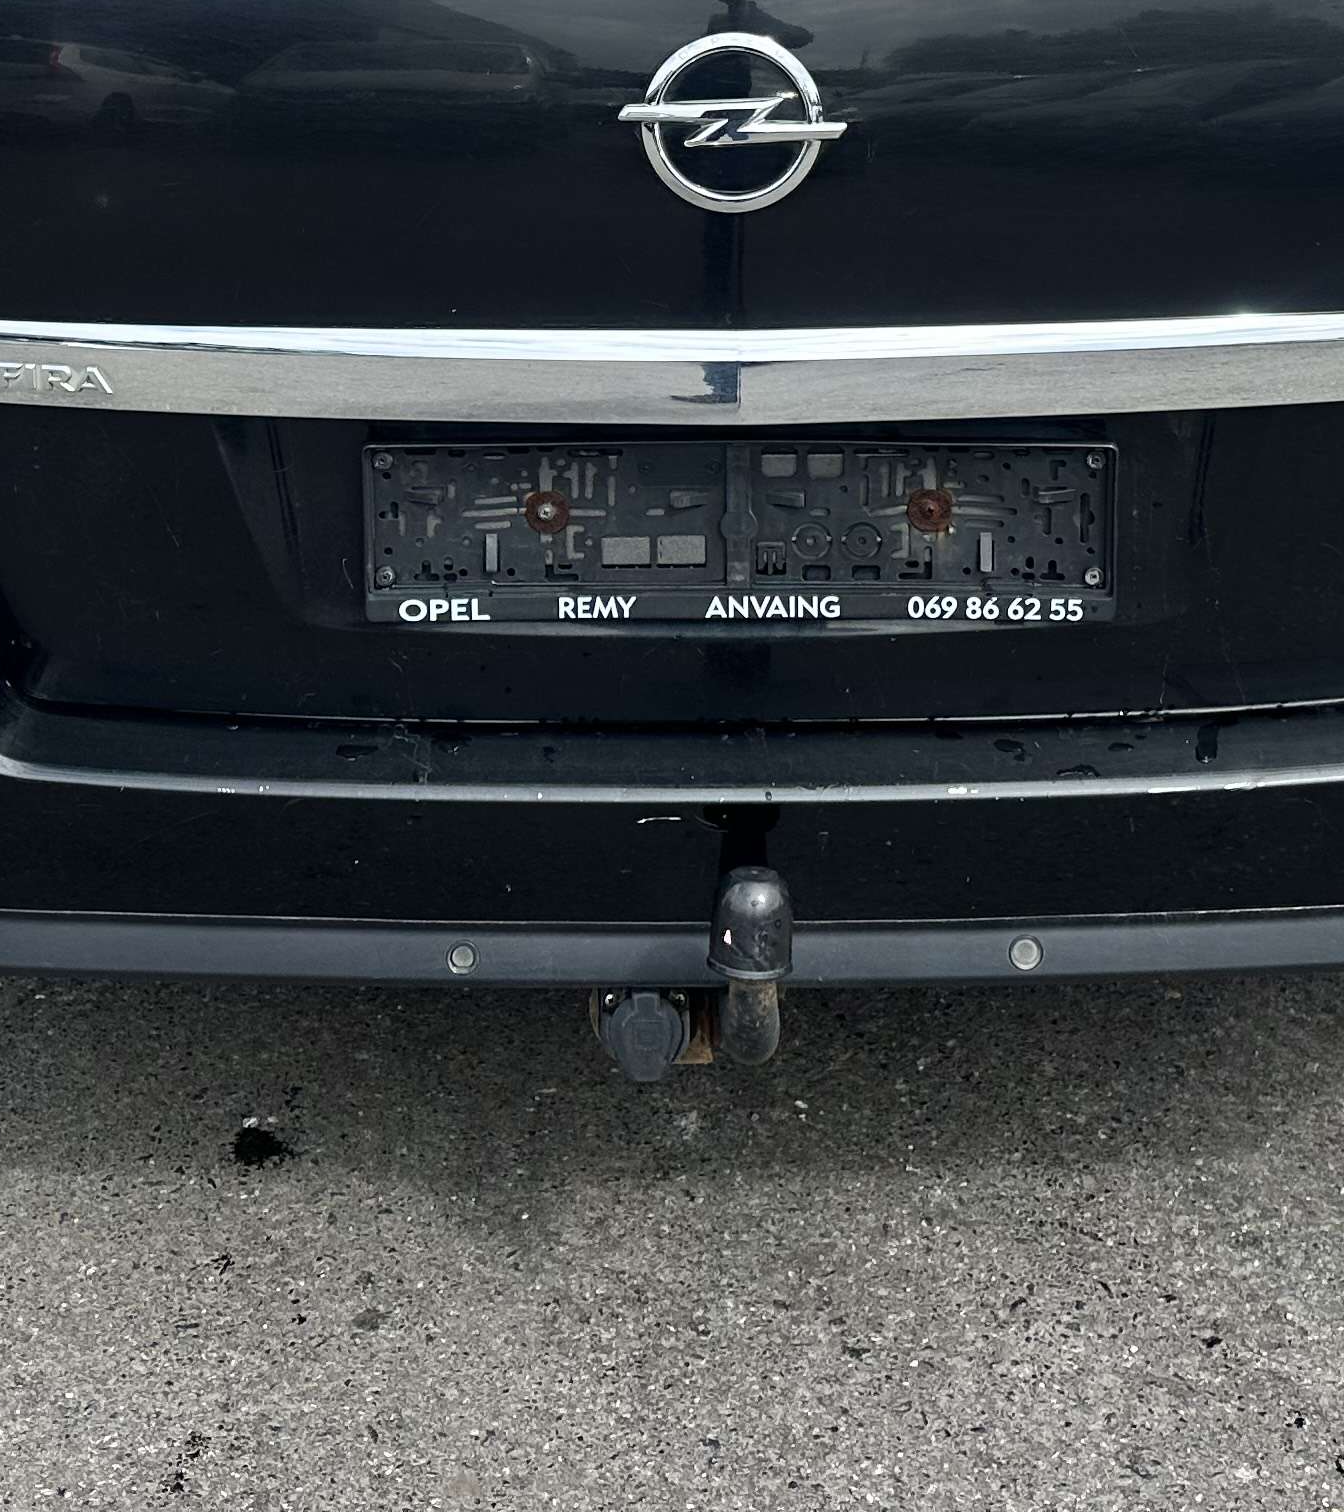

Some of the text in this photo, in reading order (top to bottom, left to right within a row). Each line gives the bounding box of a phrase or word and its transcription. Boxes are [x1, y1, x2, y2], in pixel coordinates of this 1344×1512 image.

[398, 595, 1084, 622] OPEL REMY ANVAING 069 86 62 55
